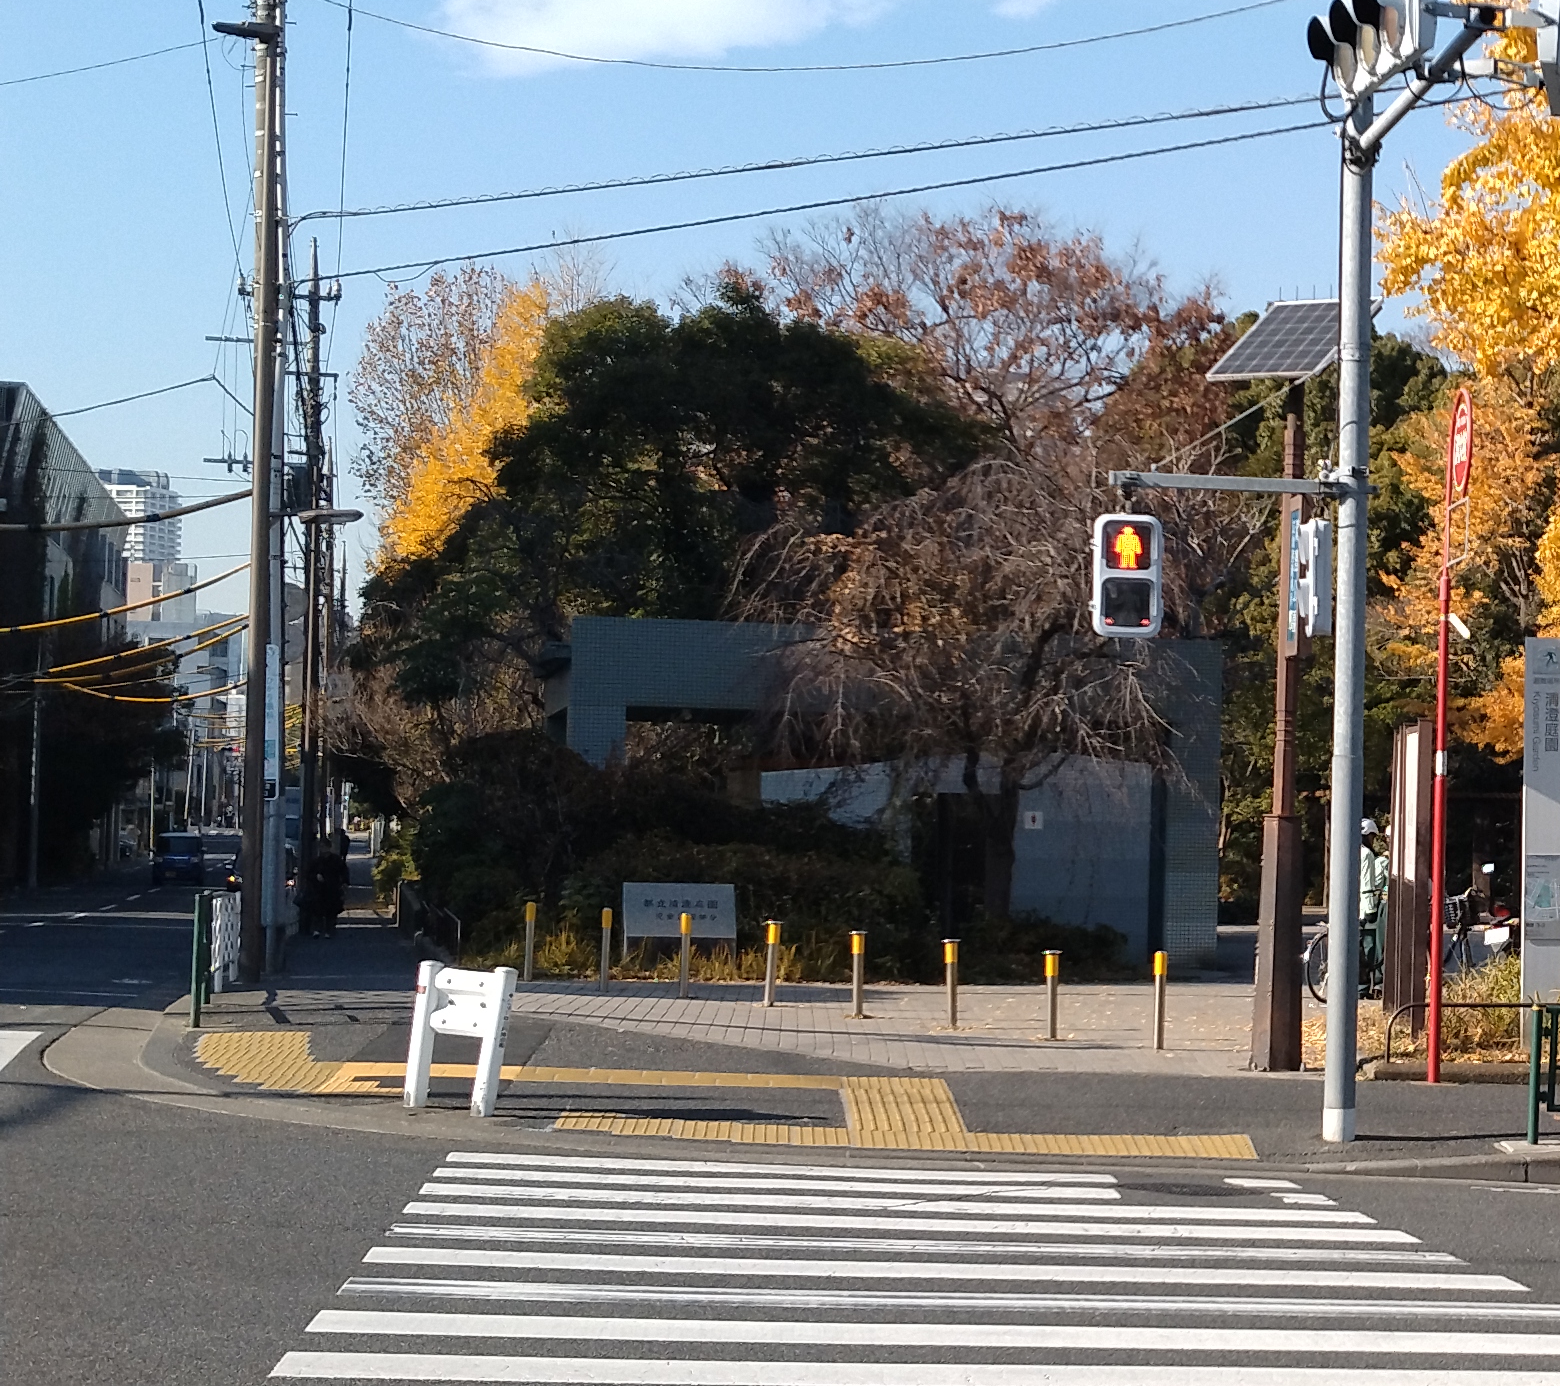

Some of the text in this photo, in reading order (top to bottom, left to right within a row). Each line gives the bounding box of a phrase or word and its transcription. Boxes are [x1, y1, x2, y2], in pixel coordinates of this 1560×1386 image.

[1531, 691, 1542, 772] Kiyosumi Garden
[1544, 692, 1559, 752] 清澄庭園
